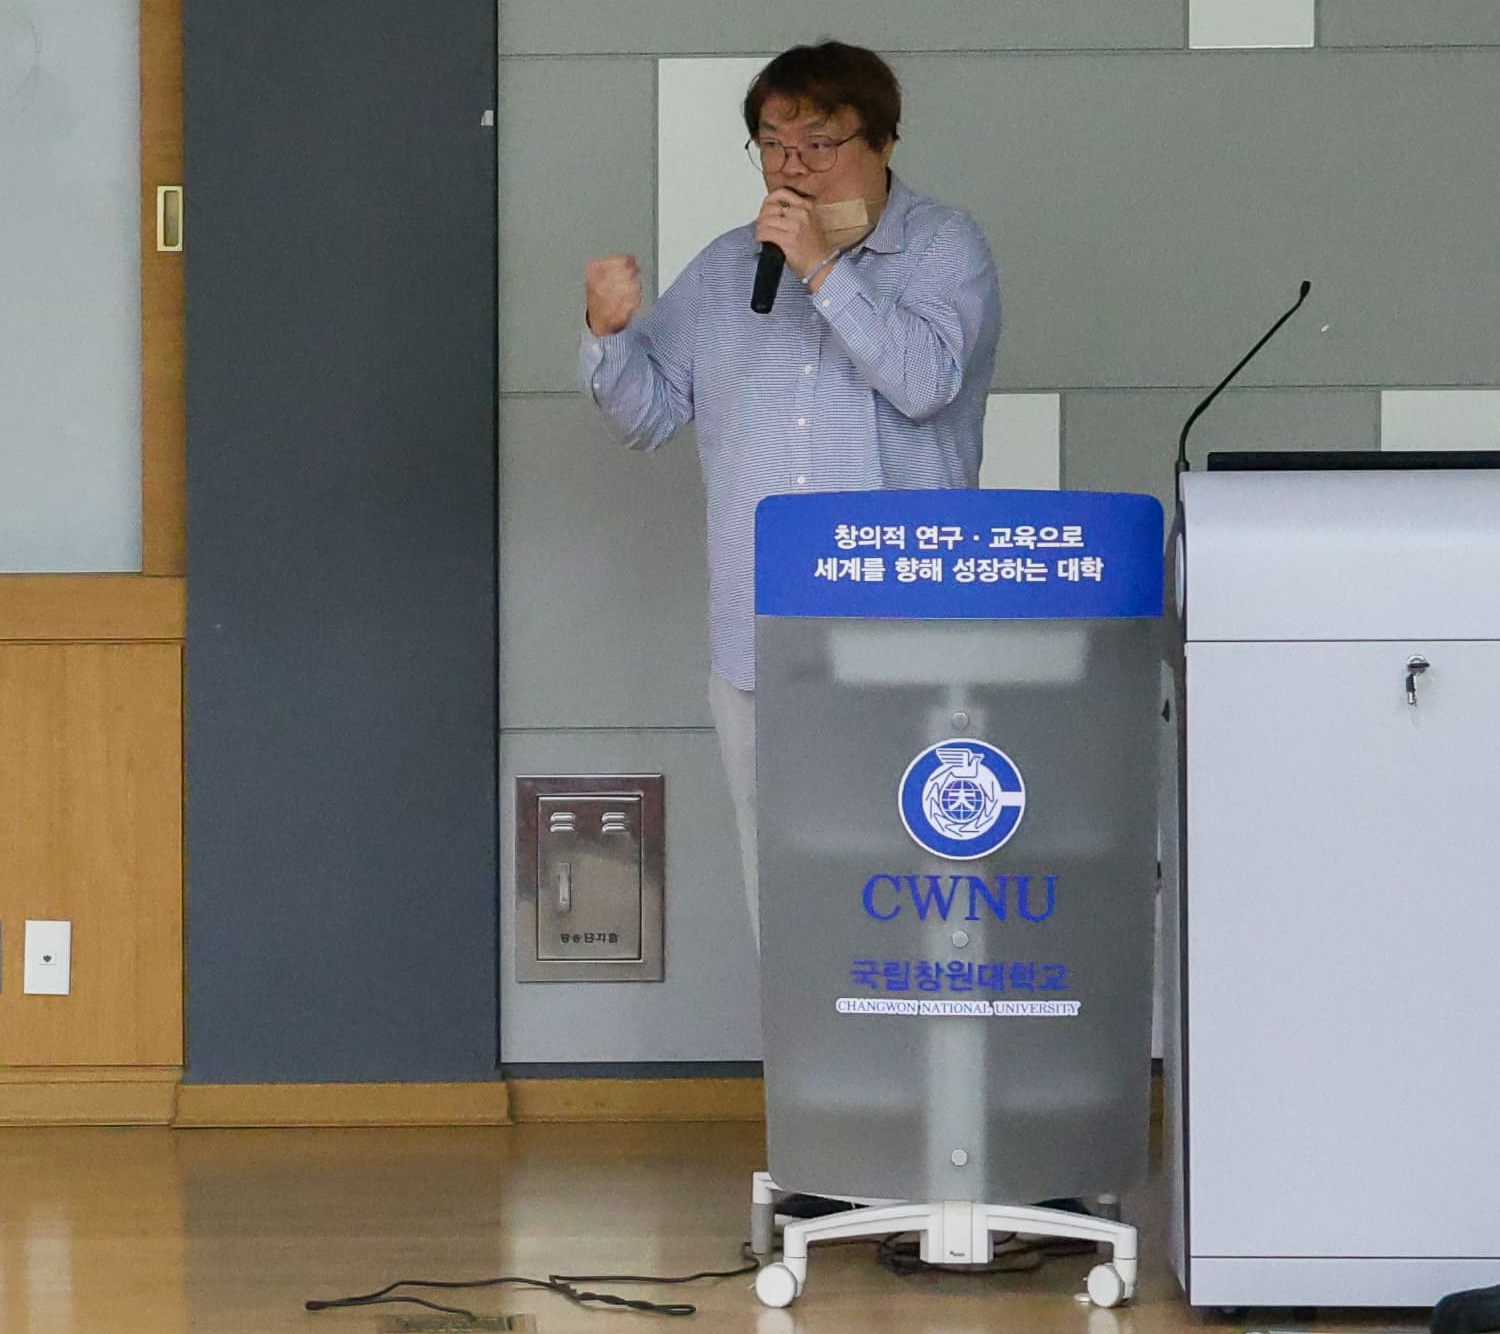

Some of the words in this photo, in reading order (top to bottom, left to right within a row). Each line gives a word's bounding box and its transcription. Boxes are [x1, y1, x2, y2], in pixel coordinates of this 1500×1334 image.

[835, 524, 905, 549] 창의적
[916, 526, 963, 550] 연구
[989, 526, 1084, 549] 교육으로
[814, 558, 885, 581] 세계를
[895, 557, 942, 582] 향해
[953, 558, 1048, 583] 성장하는
[1057, 557, 1104, 581] 대학
[862, 874, 1058, 922] CWNU
[850, 960, 1070, 992] 국립창원대학교
[838, 1000, 915, 1013] CHANGWON
[921, 1001, 989, 1014] NATIONAL
[996, 1001, 1079, 1014] UNIVERSITY
